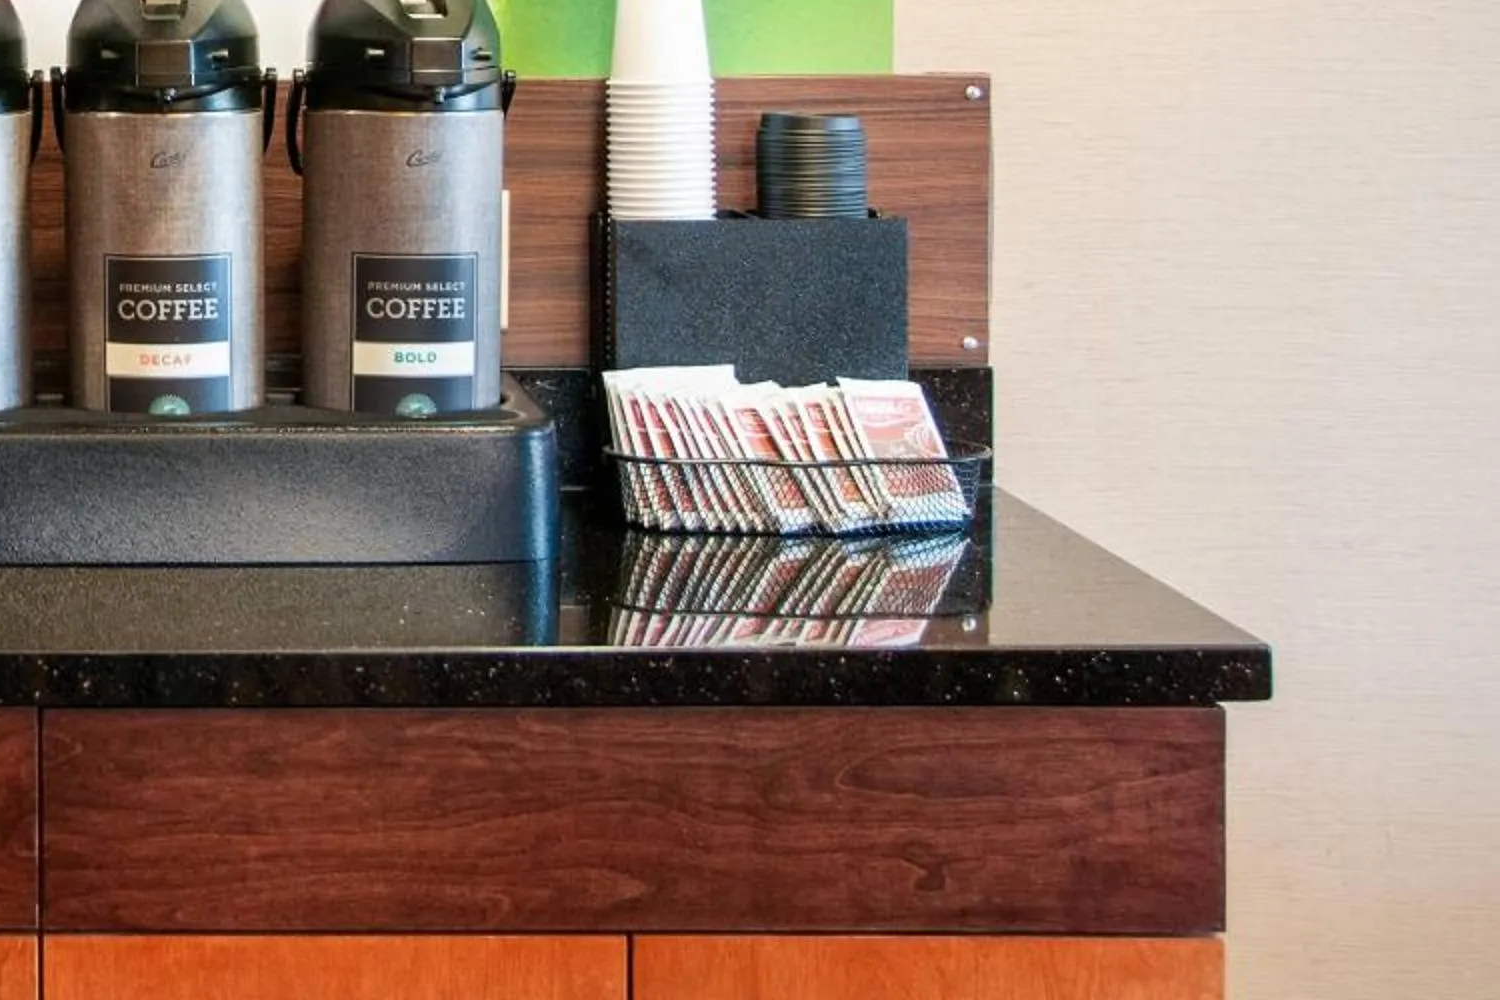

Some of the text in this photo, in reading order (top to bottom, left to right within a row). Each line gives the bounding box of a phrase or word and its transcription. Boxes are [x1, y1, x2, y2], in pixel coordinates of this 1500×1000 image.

[118, 281, 218, 294] PREMIUM SELECT
[366, 280, 466, 293] PREMIUM SELECT
[117, 298, 220, 321] COFFEE
[366, 297, 466, 320] COFFEE
[139, 353, 193, 367] DECAF
[393, 351, 438, 364] BOLD
